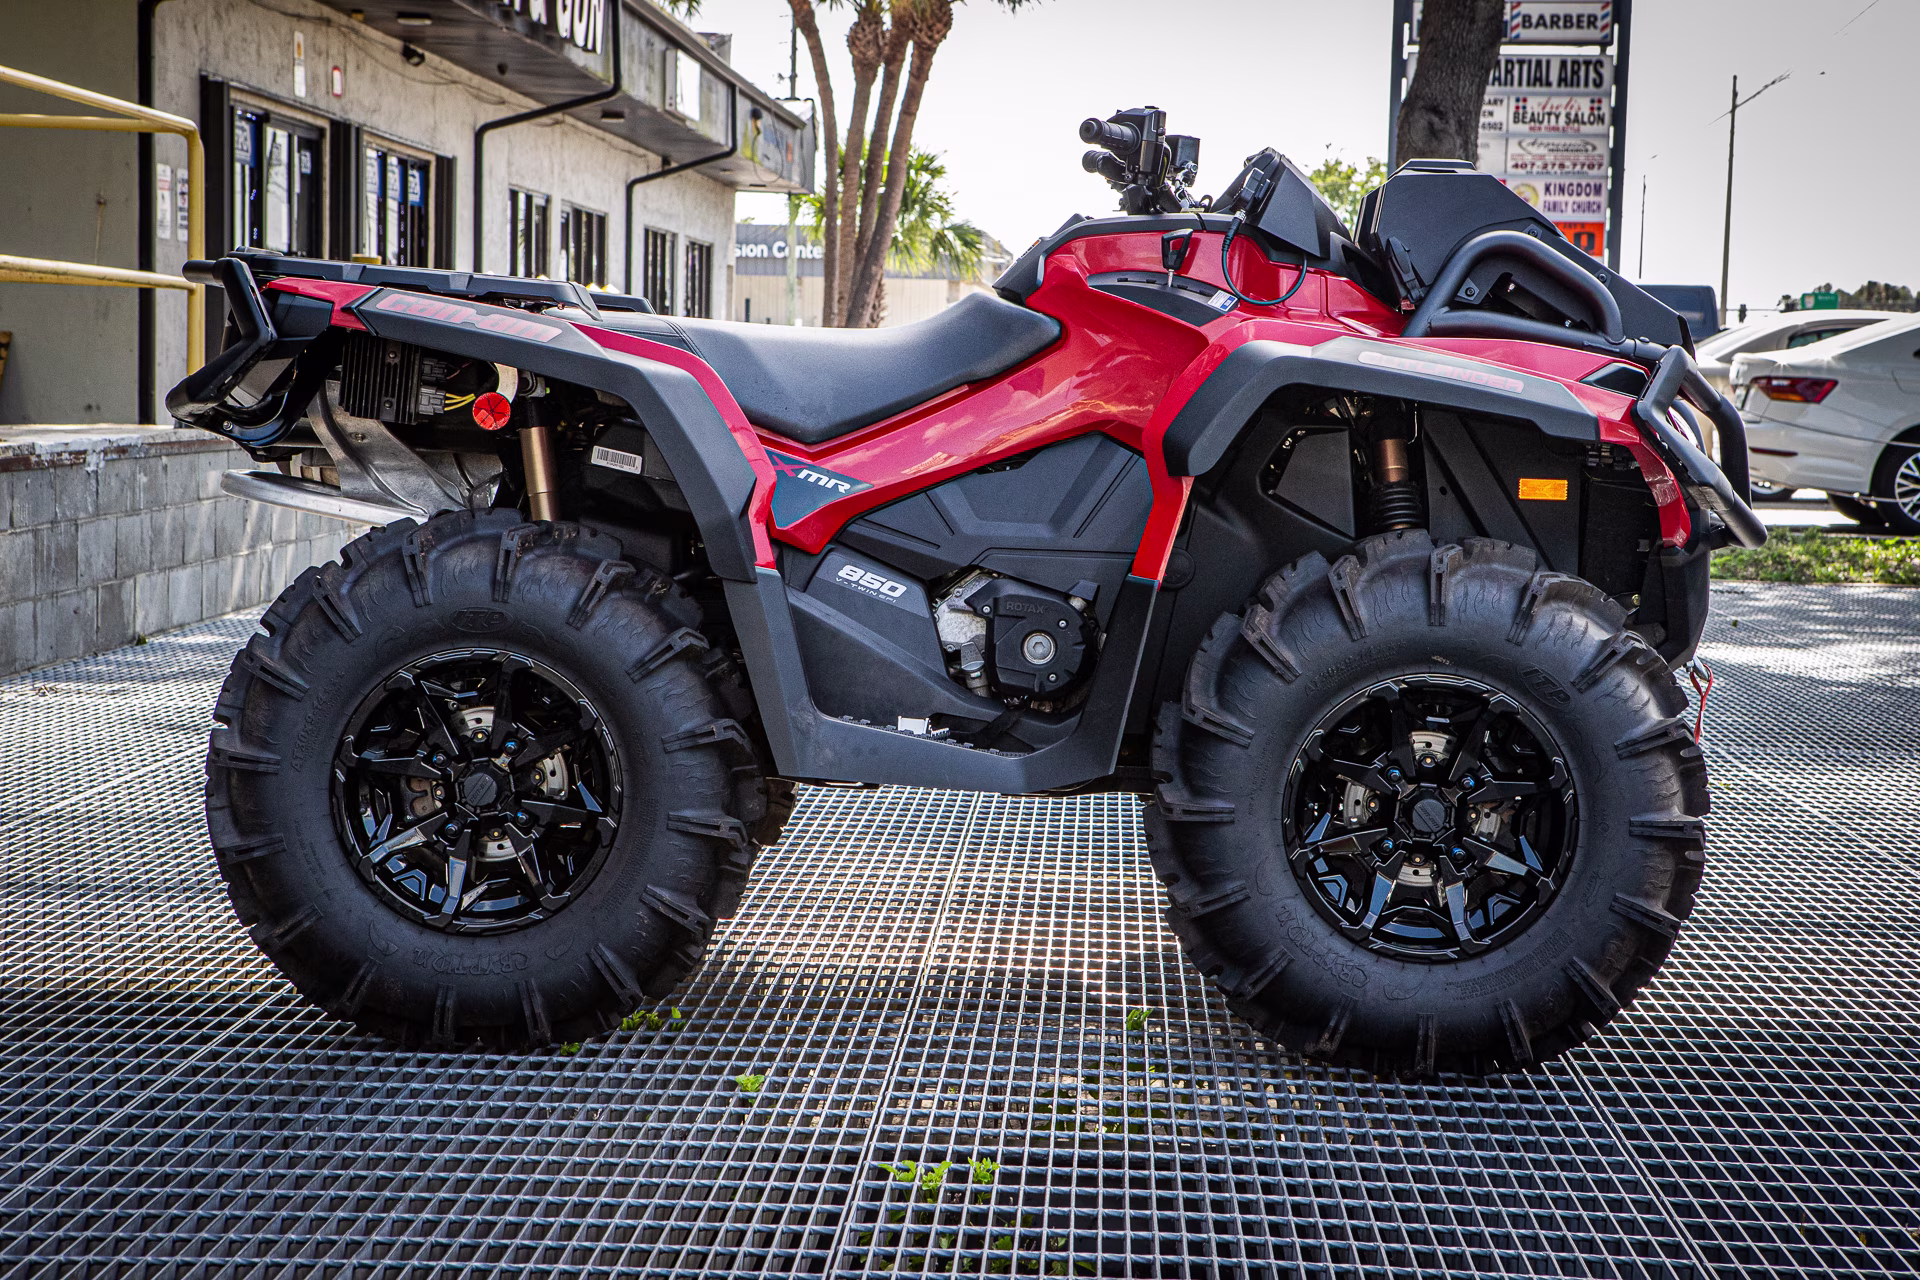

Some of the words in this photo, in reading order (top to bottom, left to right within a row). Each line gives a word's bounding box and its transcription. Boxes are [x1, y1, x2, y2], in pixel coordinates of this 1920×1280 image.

[1521, 13, 1599, 30] BARBER
[1489, 58, 1553, 88] ARTIAL
[1557, 58, 1604, 88] ARTS
[1513, 111, 1561, 124] BEAUTY
[1564, 111, 1605, 126] SALON
[1544, 183, 1602, 196] KINGDOM
[1543, 200, 1569, 213] FAMILY
[1571, 200, 1601, 213] CHURCH
[837, 564, 907, 598] 850
[1006, 601, 1044, 614] ROTAX
[1521, 666, 1571, 704] ITP
